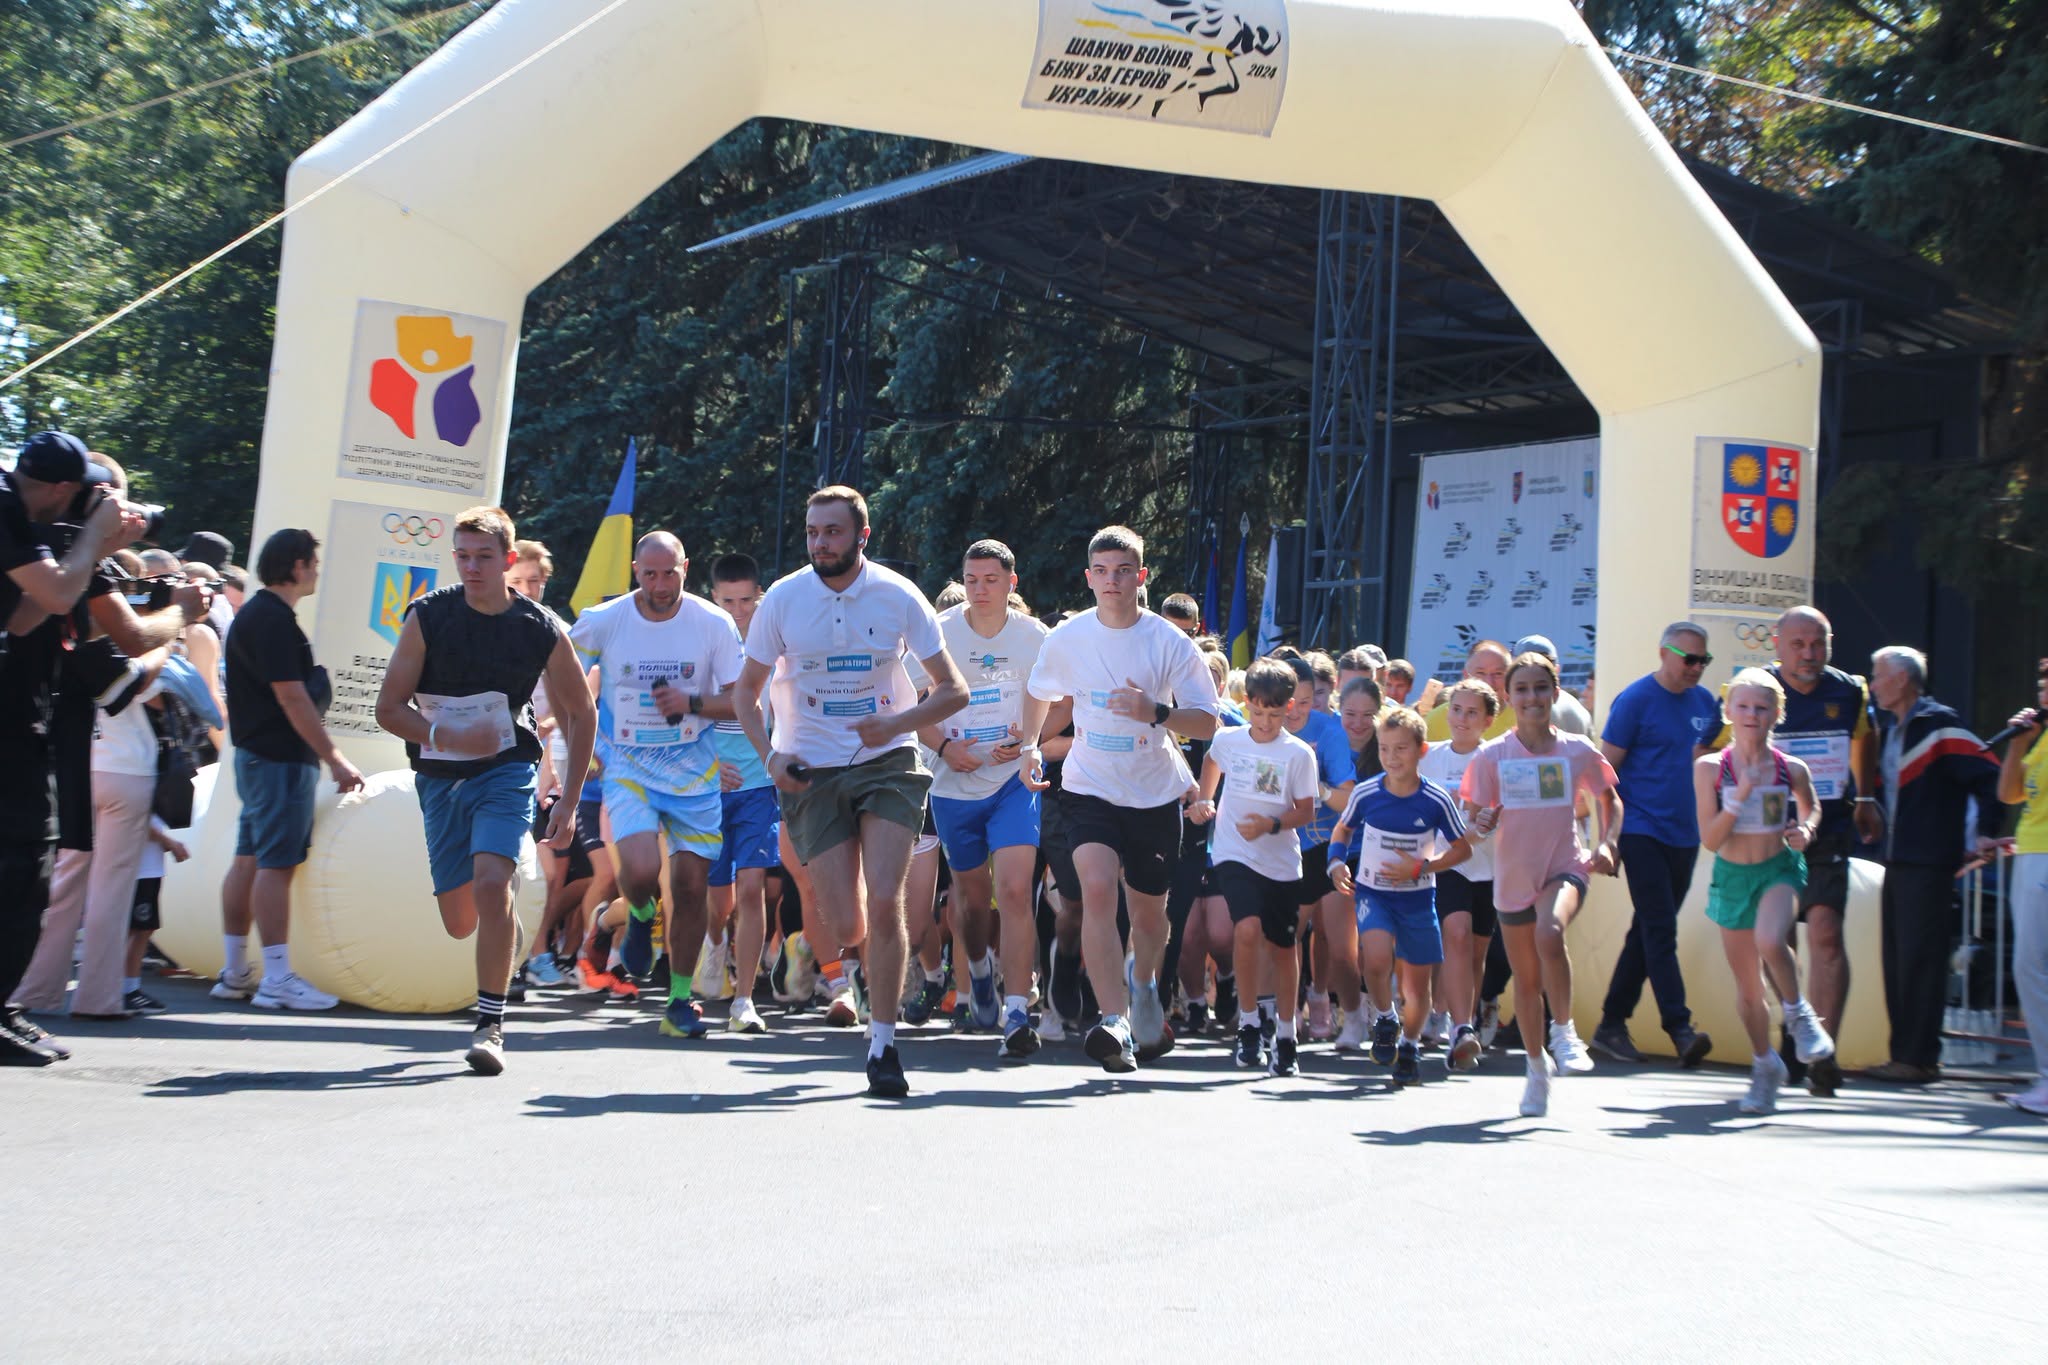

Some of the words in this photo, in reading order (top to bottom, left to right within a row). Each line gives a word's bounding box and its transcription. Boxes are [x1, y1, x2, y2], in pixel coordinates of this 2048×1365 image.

[1064, 36, 1134, 61] ШАНУЮ
[1132, 44, 1193, 71] ВОЇНІВ,
[1040, 58, 1090, 80] БІЖУ
[1086, 64, 1112, 83] ЗА
[1110, 67, 1171, 89] ГЕРОЇВ
[1246, 63, 1278, 80] 2024
[353, 444, 423, 459] ДЕПАРТАМЕНТ
[357, 467, 413, 480] ДЕРЖАВНОЇ
[394, 460, 450, 474] ВІННИЦЬКОЇ
[377, 549, 440, 563] UKRAINE
[639, 664, 679, 672] ПОЛІЦІЯ
